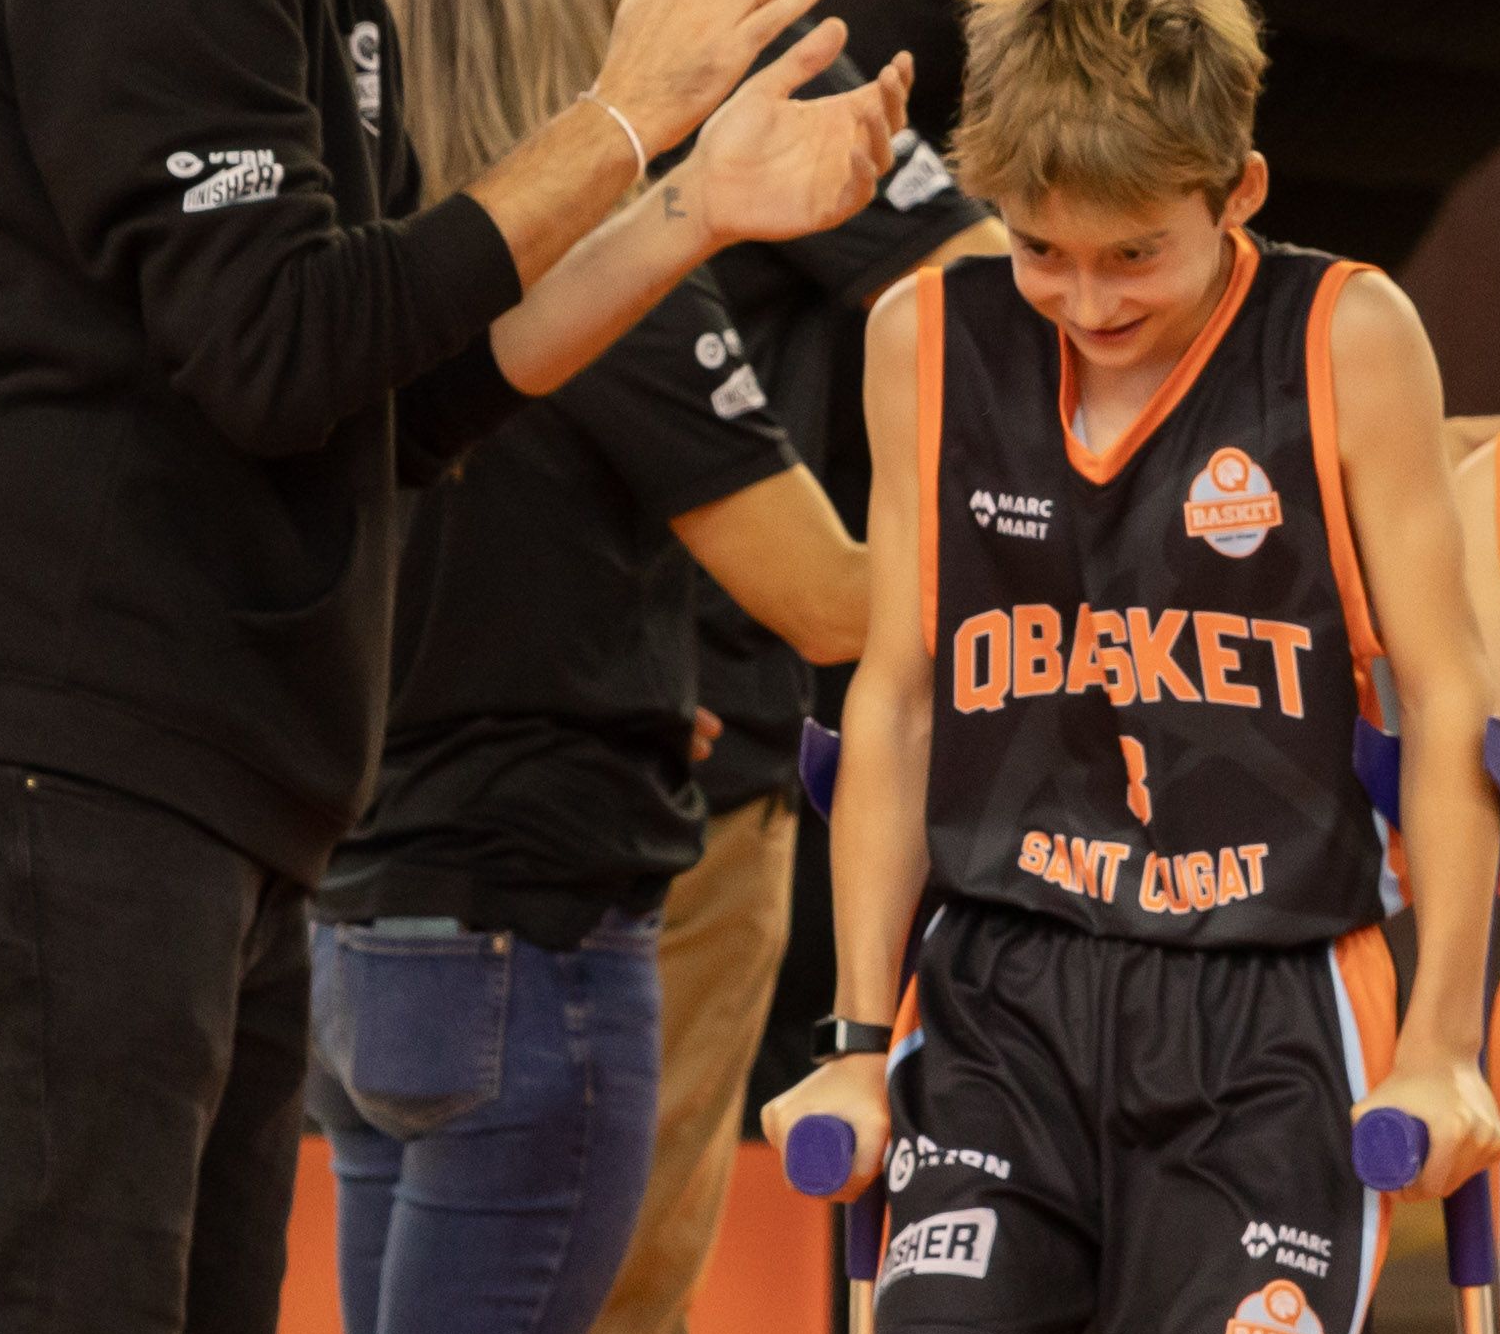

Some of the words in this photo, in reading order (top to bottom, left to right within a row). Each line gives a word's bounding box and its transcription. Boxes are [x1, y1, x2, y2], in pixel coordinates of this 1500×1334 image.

[998, 492, 1053, 518] MARC
[997, 516, 1048, 540] MART
[954, 603, 1311, 719] QBASKET
[1019, 831, 1131, 903] SANT
[1139, 845, 1268, 914] CUGAT
[1278, 1224, 1332, 1257] MARC
[1275, 1247, 1330, 1279] MART
